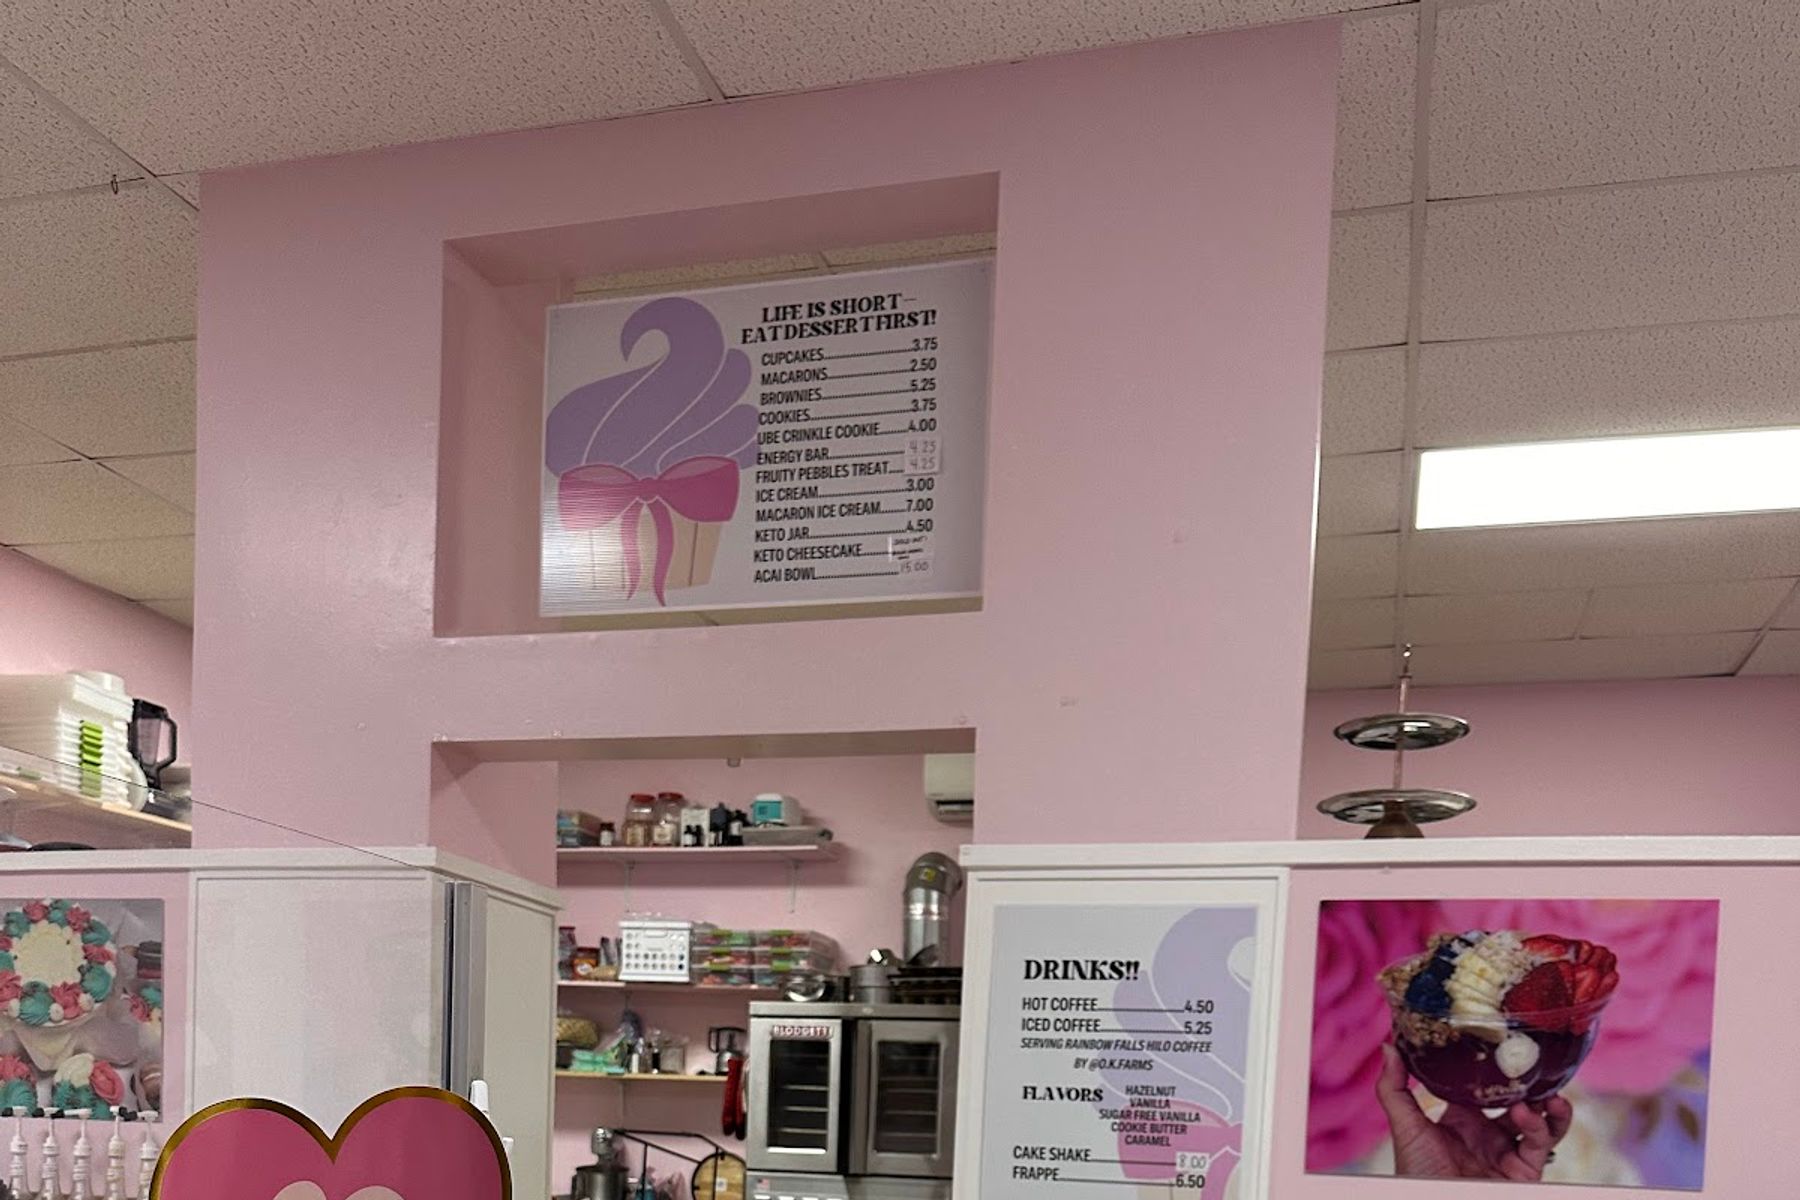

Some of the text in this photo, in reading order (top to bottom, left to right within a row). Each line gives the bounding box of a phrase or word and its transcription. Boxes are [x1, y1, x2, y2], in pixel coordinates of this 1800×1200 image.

[762, 304, 803, 323] LIFE
[808, 301, 826, 319] IS
[741, 309, 937, 344] EAT DESSERT FIRST!
[761, 337, 938, 366] CUPCAKES 3.75
[760, 358, 937, 386] MACARONS 2.50
[760, 378, 936, 406] BROWNIES 5.25
[758, 398, 937, 425] COOKIES 3.75
[757, 418, 937, 446] UBE CRINKLE COOKIE 4.00
[757, 449, 803, 466] ENERGY
[805, 448, 829, 462] BAR
[756, 468, 798, 484] FRUITY
[799, 464, 850, 481] PEBBLES
[852, 461, 890, 477] TREAT
[756, 478, 935, 503] ICE CREAM 3.00
[756, 499, 934, 523] MACARON ICE CREAM 7.00
[755, 519, 934, 542] KETO JAR 4.50
[754, 543, 863, 563] KETO CHEESECAKE
[754, 569, 782, 583] ACAI
[784, 567, 818, 582] BOWL
[1023, 959, 1140, 981] DRINKS!!
[1022, 997, 1214, 1014] HOT COFFEE 4.50
[1021, 1018, 1213, 1035] ICED COFFEE 5.25
[1020, 1037, 1213, 1053] SERVING RAINBOW FALLS HILO COFFEE
[1074, 1057, 1089, 1069] BY
[1022, 1086, 1104, 1102] FLAVORS
[1125, 1085, 1176, 1097] HAZELNUT
[1130, 1098, 1171, 1109] VANILLA
[1099, 1109, 1201, 1123] SUGAR FREE VANILLA
[1111, 1122, 1187, 1135] COOKIE BUTTER
[1125, 1135, 1171, 1147] CARAMEL
[1013, 1146, 1047, 1160] CAKE
[1048, 1148, 1091, 1162] SHAKE
[1012, 1166, 1206, 1189] FRAPPE 6.50
